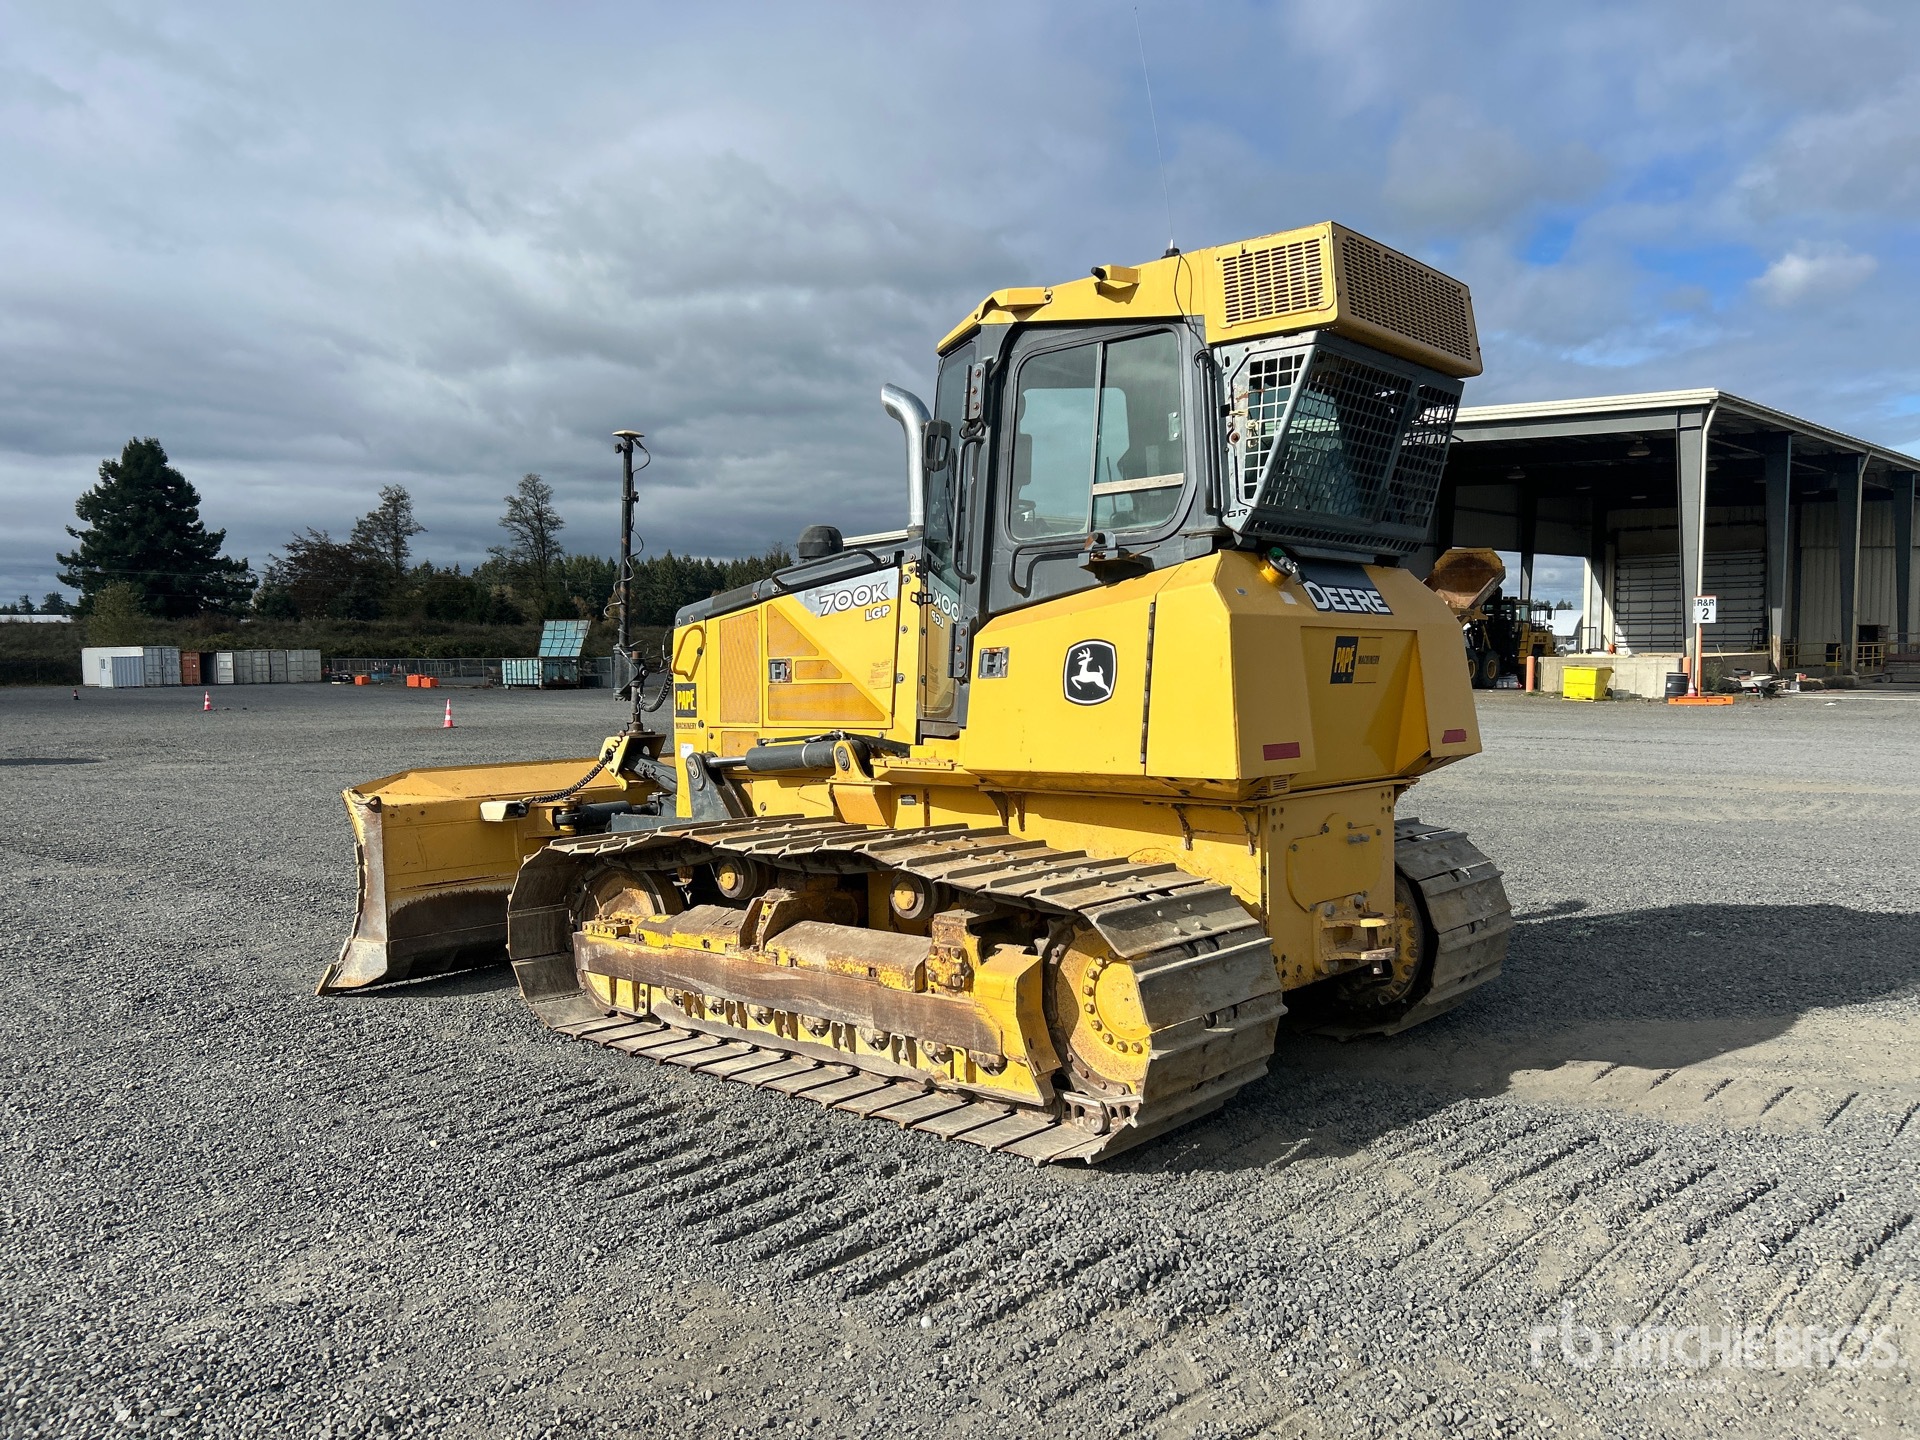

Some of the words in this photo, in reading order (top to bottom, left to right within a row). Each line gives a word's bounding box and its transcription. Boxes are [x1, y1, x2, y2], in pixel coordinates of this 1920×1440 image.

[819, 581, 889, 617] 700K
[1302, 580, 1391, 612] DEERE
[864, 605, 891, 622] LGP
[1702, 608, 1709, 620] 2
